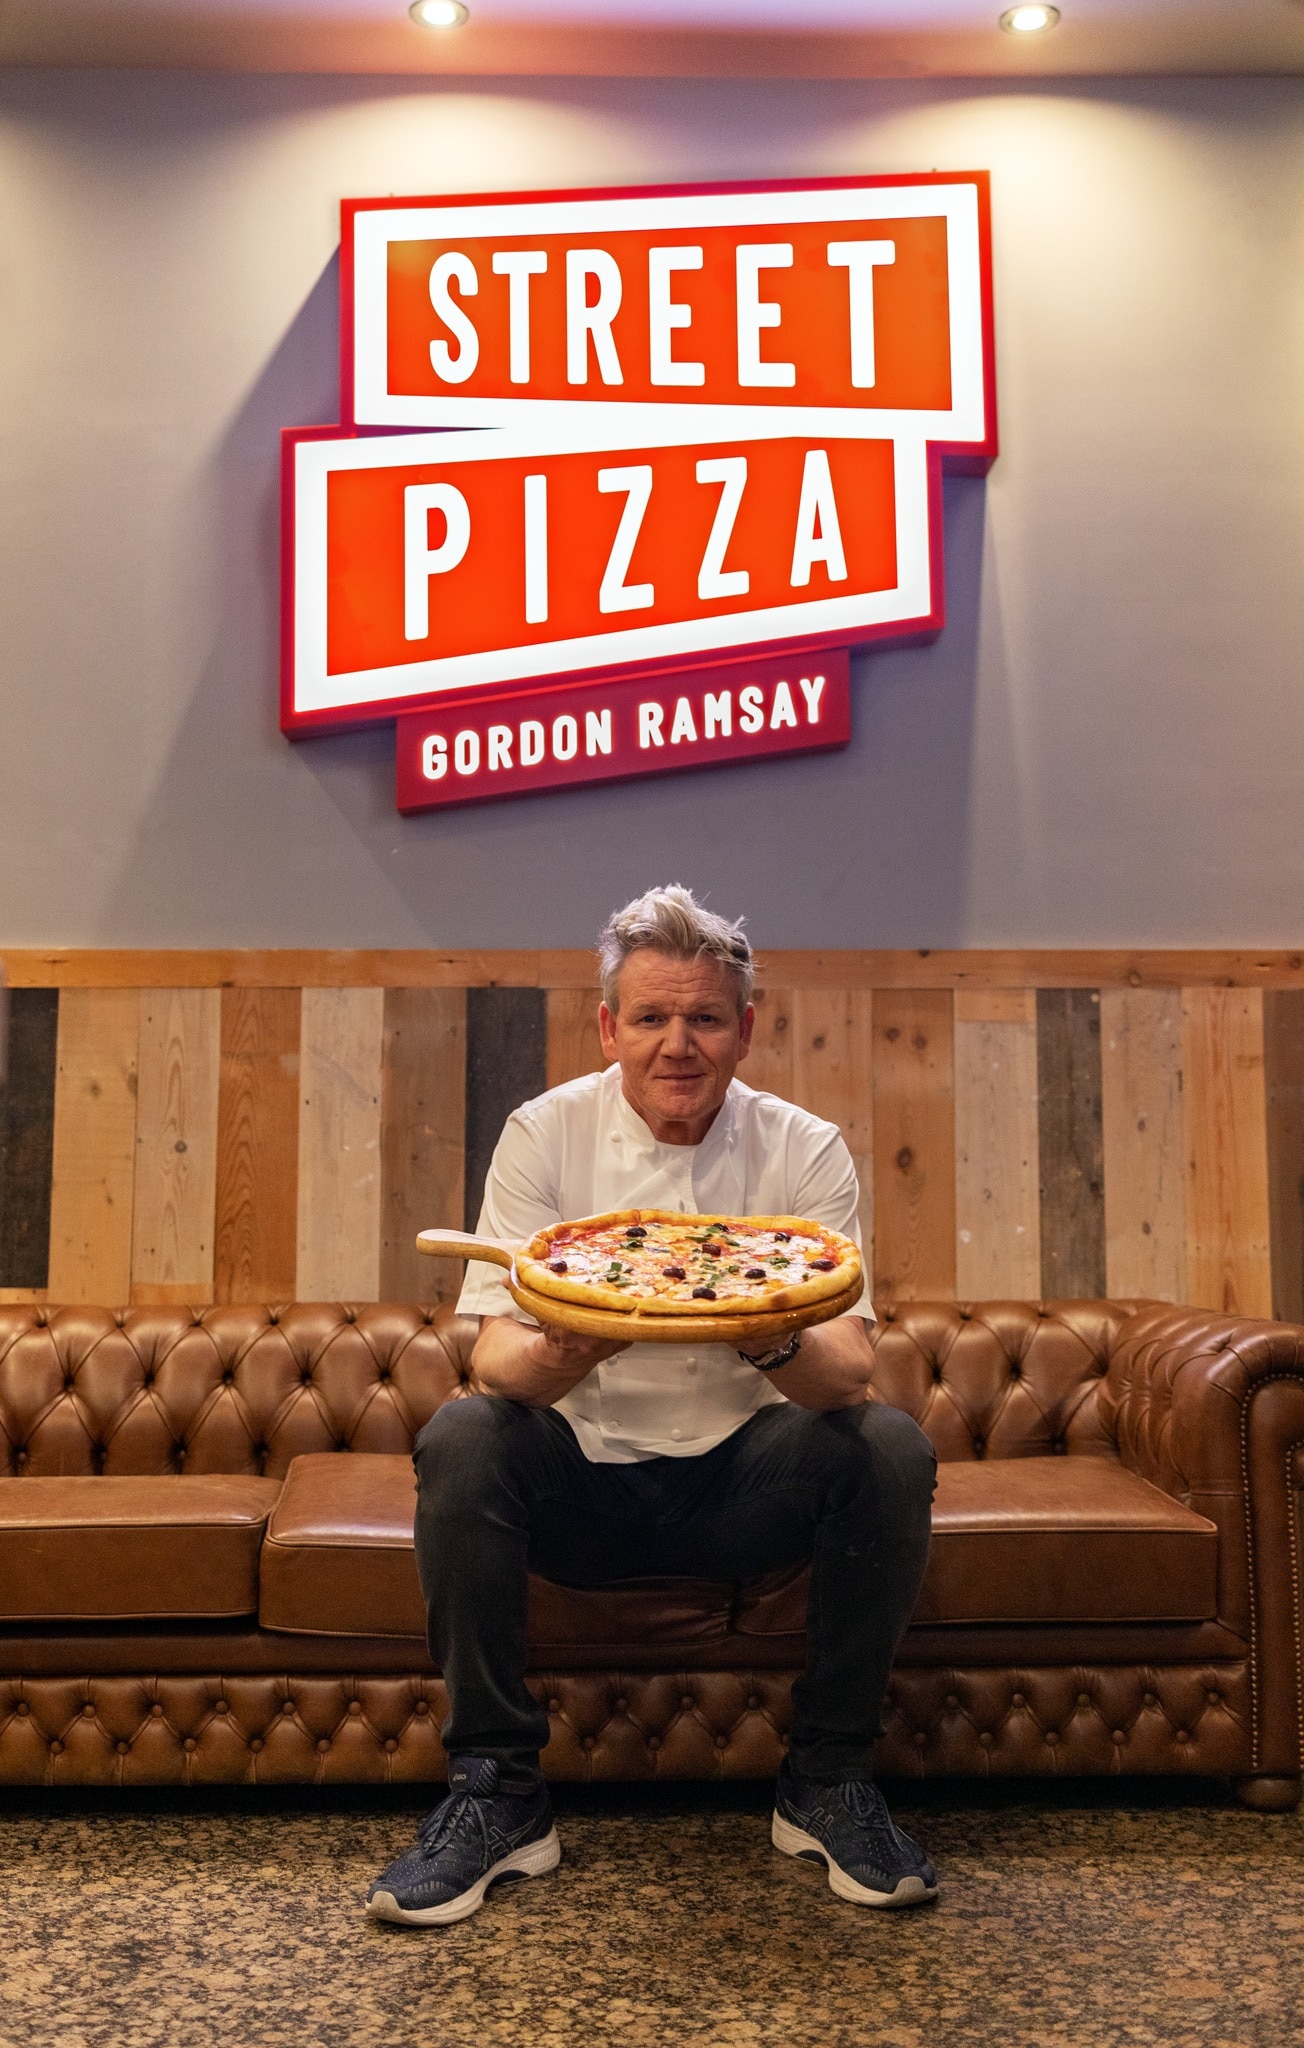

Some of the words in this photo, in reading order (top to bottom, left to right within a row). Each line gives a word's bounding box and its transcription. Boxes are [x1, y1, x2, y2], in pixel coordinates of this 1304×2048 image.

[429, 240, 896, 389] STREET
[404, 449, 848, 641] PIZZA
[422, 708, 613, 780] GORDON
[639, 676, 826, 750] RAMSAY
